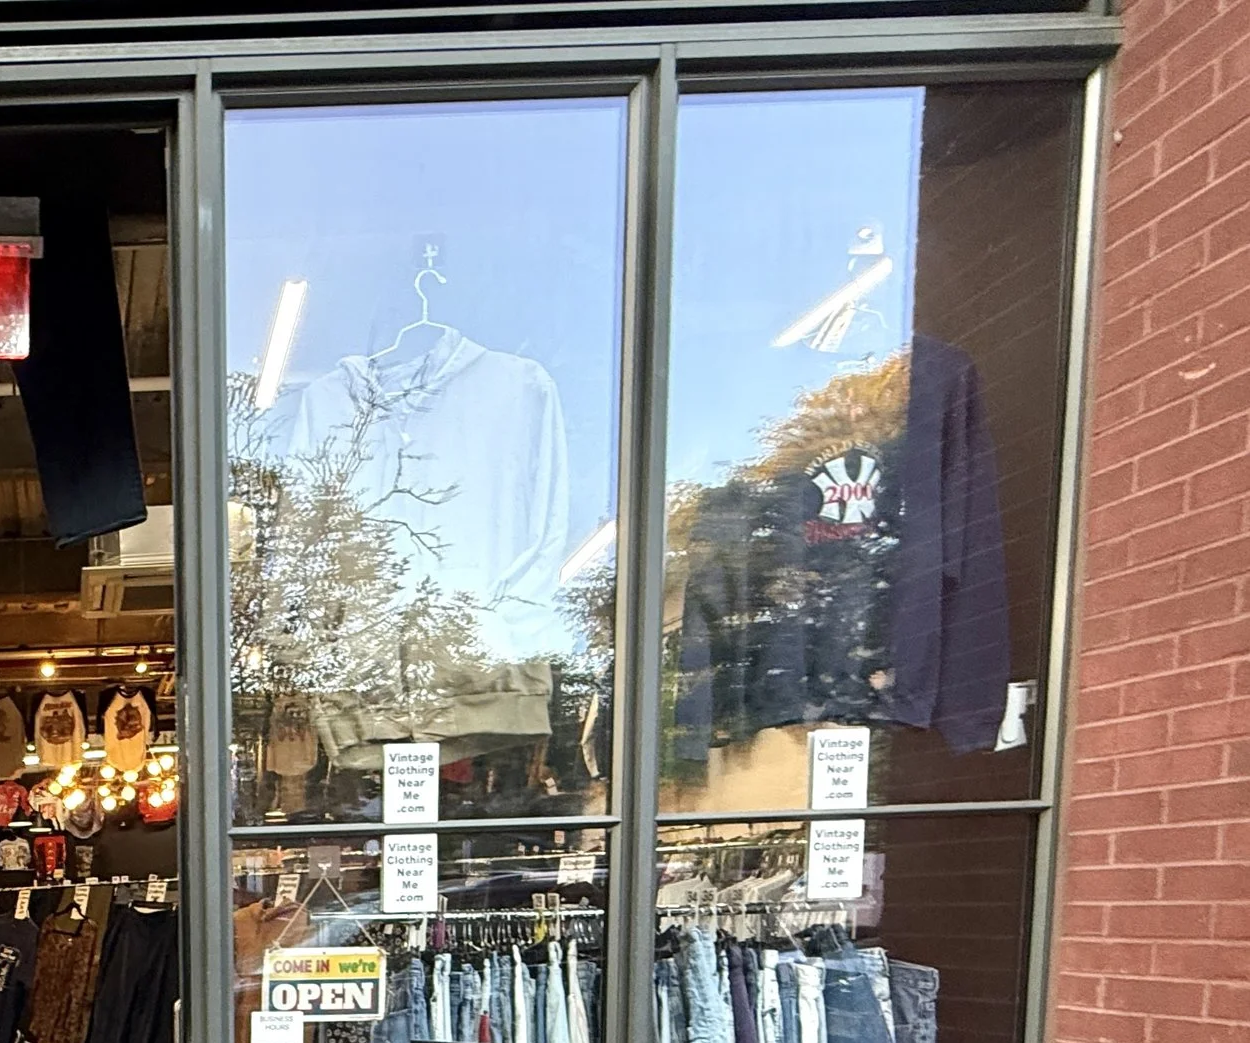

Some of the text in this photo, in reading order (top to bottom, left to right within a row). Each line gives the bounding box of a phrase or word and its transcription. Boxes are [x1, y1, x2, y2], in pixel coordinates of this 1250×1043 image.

[819, 739, 863, 750] Vintage
[389, 753, 434, 764] Vintage
[817, 752, 864, 762] Clothing
[388, 766, 434, 776] Clothing
[826, 765, 854, 773] Near
[398, 779, 425, 787] Near
[832, 778, 848, 786] Me
[403, 792, 420, 800] Me
[815, 829, 859, 840] Vintage
[388, 843, 432, 853] Vintage
[814, 842, 860, 852] Clothing
[387, 856, 433, 865] Clothing
[823, 855, 850, 863] Near
[397, 868, 424, 876] Near
[827, 867, 844, 875] Me
[402, 881, 418, 889] Me
[273, 959, 377, 973] COME IN we're
[272, 982, 374, 1011] OPEN
